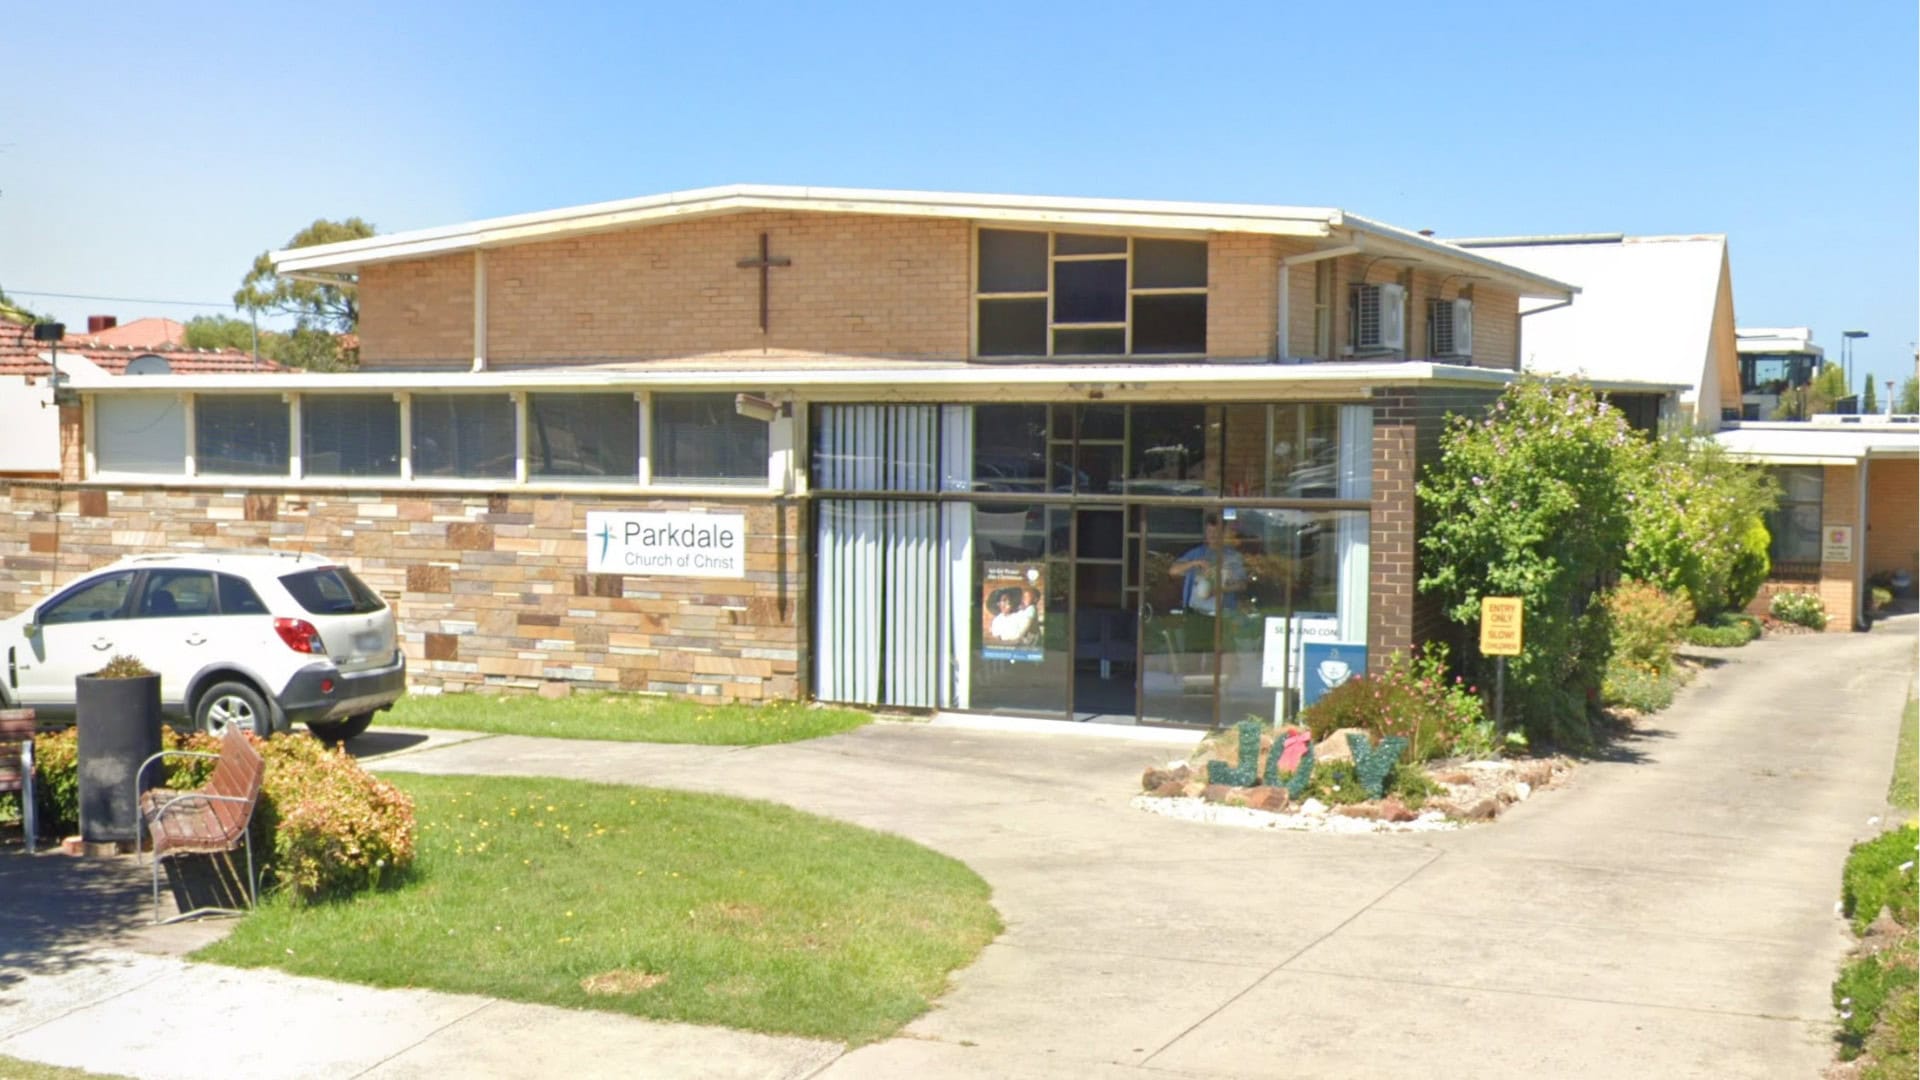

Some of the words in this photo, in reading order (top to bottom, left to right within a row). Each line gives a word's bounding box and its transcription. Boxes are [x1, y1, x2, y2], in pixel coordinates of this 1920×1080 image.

[624, 521, 734, 549] Parkdale
[624, 551, 673, 567] Church
[676, 554, 690, 567] of
[694, 554, 734, 569] Christ
[1489, 604, 1515, 613] ENTRY
[1490, 614, 1512, 623] ONLY
[1207, 720, 1409, 800] JOY
